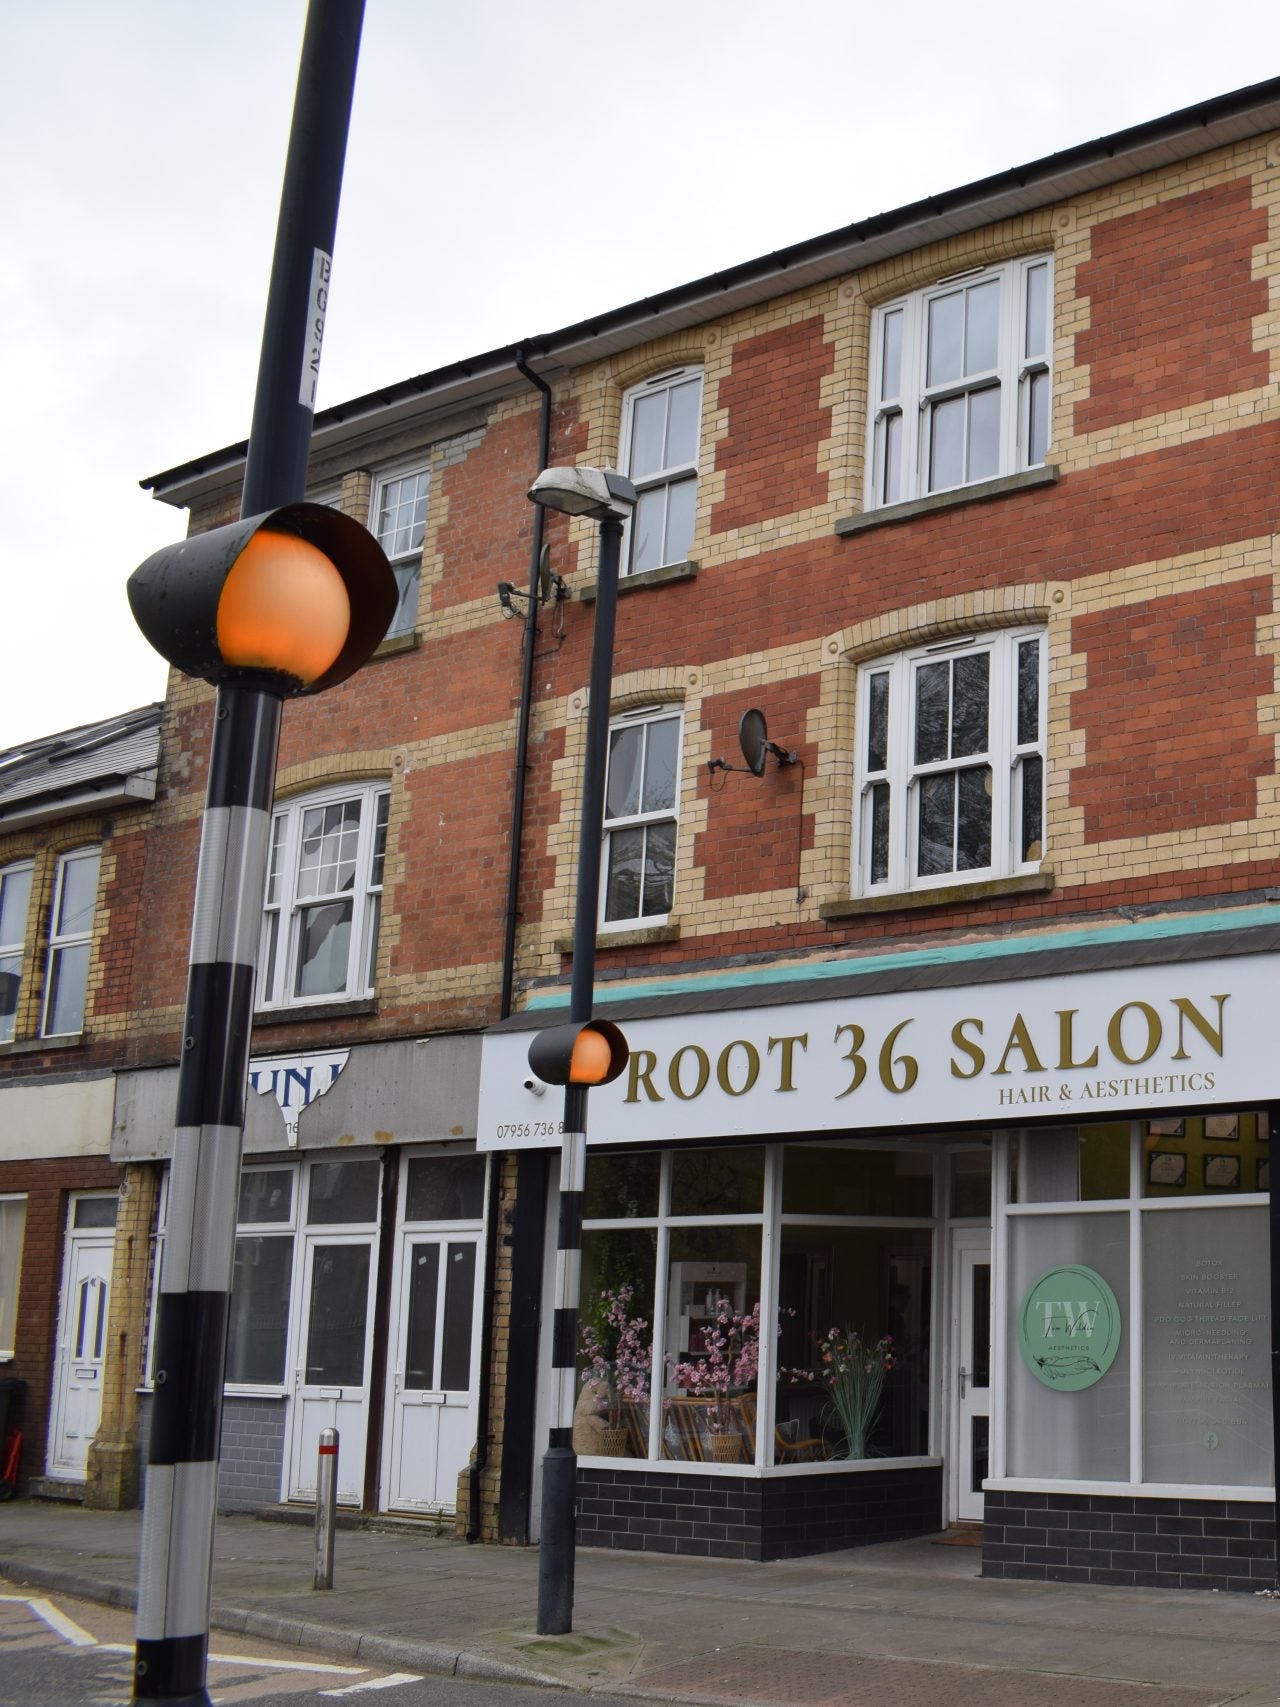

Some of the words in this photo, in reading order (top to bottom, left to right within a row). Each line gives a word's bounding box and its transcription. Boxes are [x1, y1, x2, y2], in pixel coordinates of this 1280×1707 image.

[622, 1032, 808, 1104] ROOT
[834, 1017, 919, 1100] 36
[950, 993, 1231, 1078] SALON
[998, 1085, 1052, 1105] HAIR
[1058, 1083, 1073, 1101] &
[1080, 1072, 1216, 1099] AESTHETICS
[497, 1123, 530, 1139] 07956
[534, 1122, 554, 1136] 736
[1036, 1301, 1100, 1337] TW
